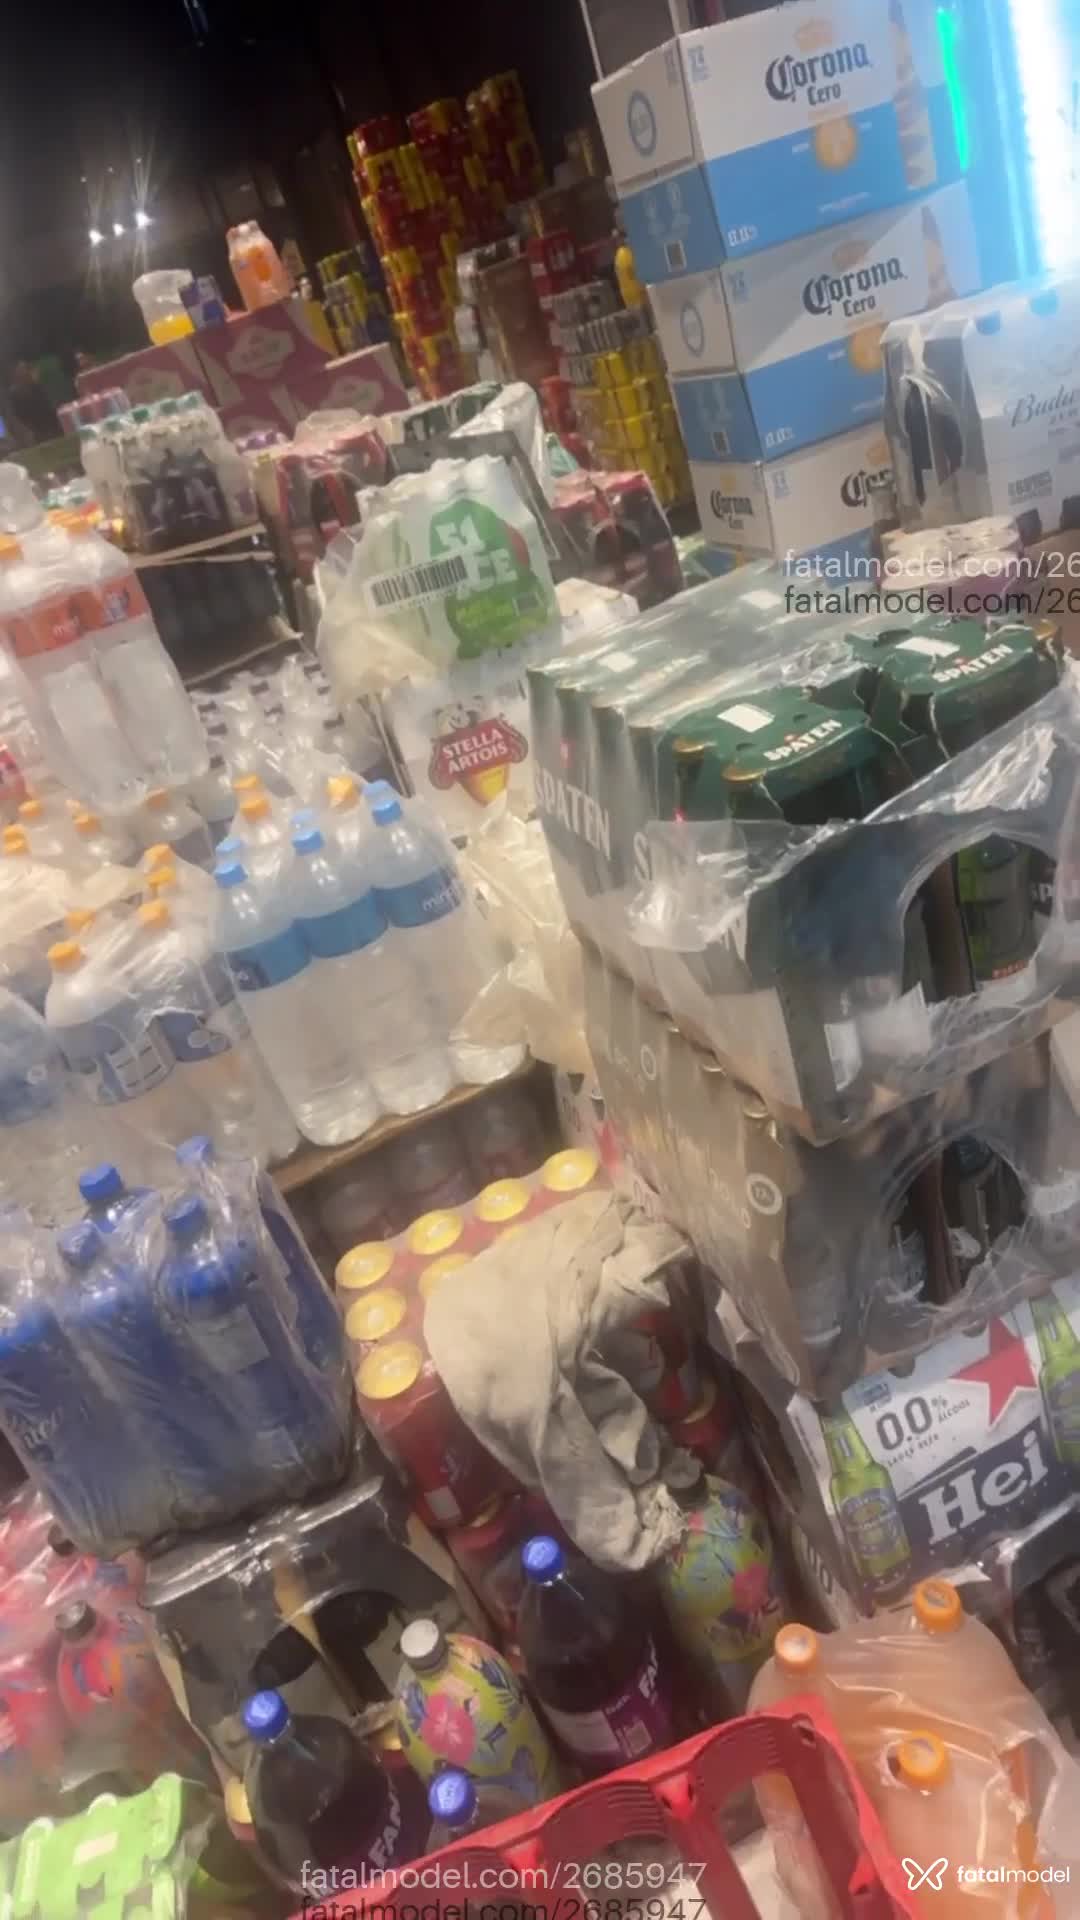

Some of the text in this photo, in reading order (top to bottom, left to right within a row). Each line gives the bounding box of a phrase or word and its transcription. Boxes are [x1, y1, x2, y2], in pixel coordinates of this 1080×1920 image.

[765, 43, 871, 102] Corona
[807, 83, 841, 106] Cero
[802, 257, 905, 316] Corona
[842, 295, 877, 318] Cero
[933, 644, 1013, 683] SPATEN
[442, 728, 504, 759] STELLA
[448, 741, 508, 775] ARTOIS
[763, 719, 842, 760] SPATEN
[918, 1429, 1049, 1545] Hei
